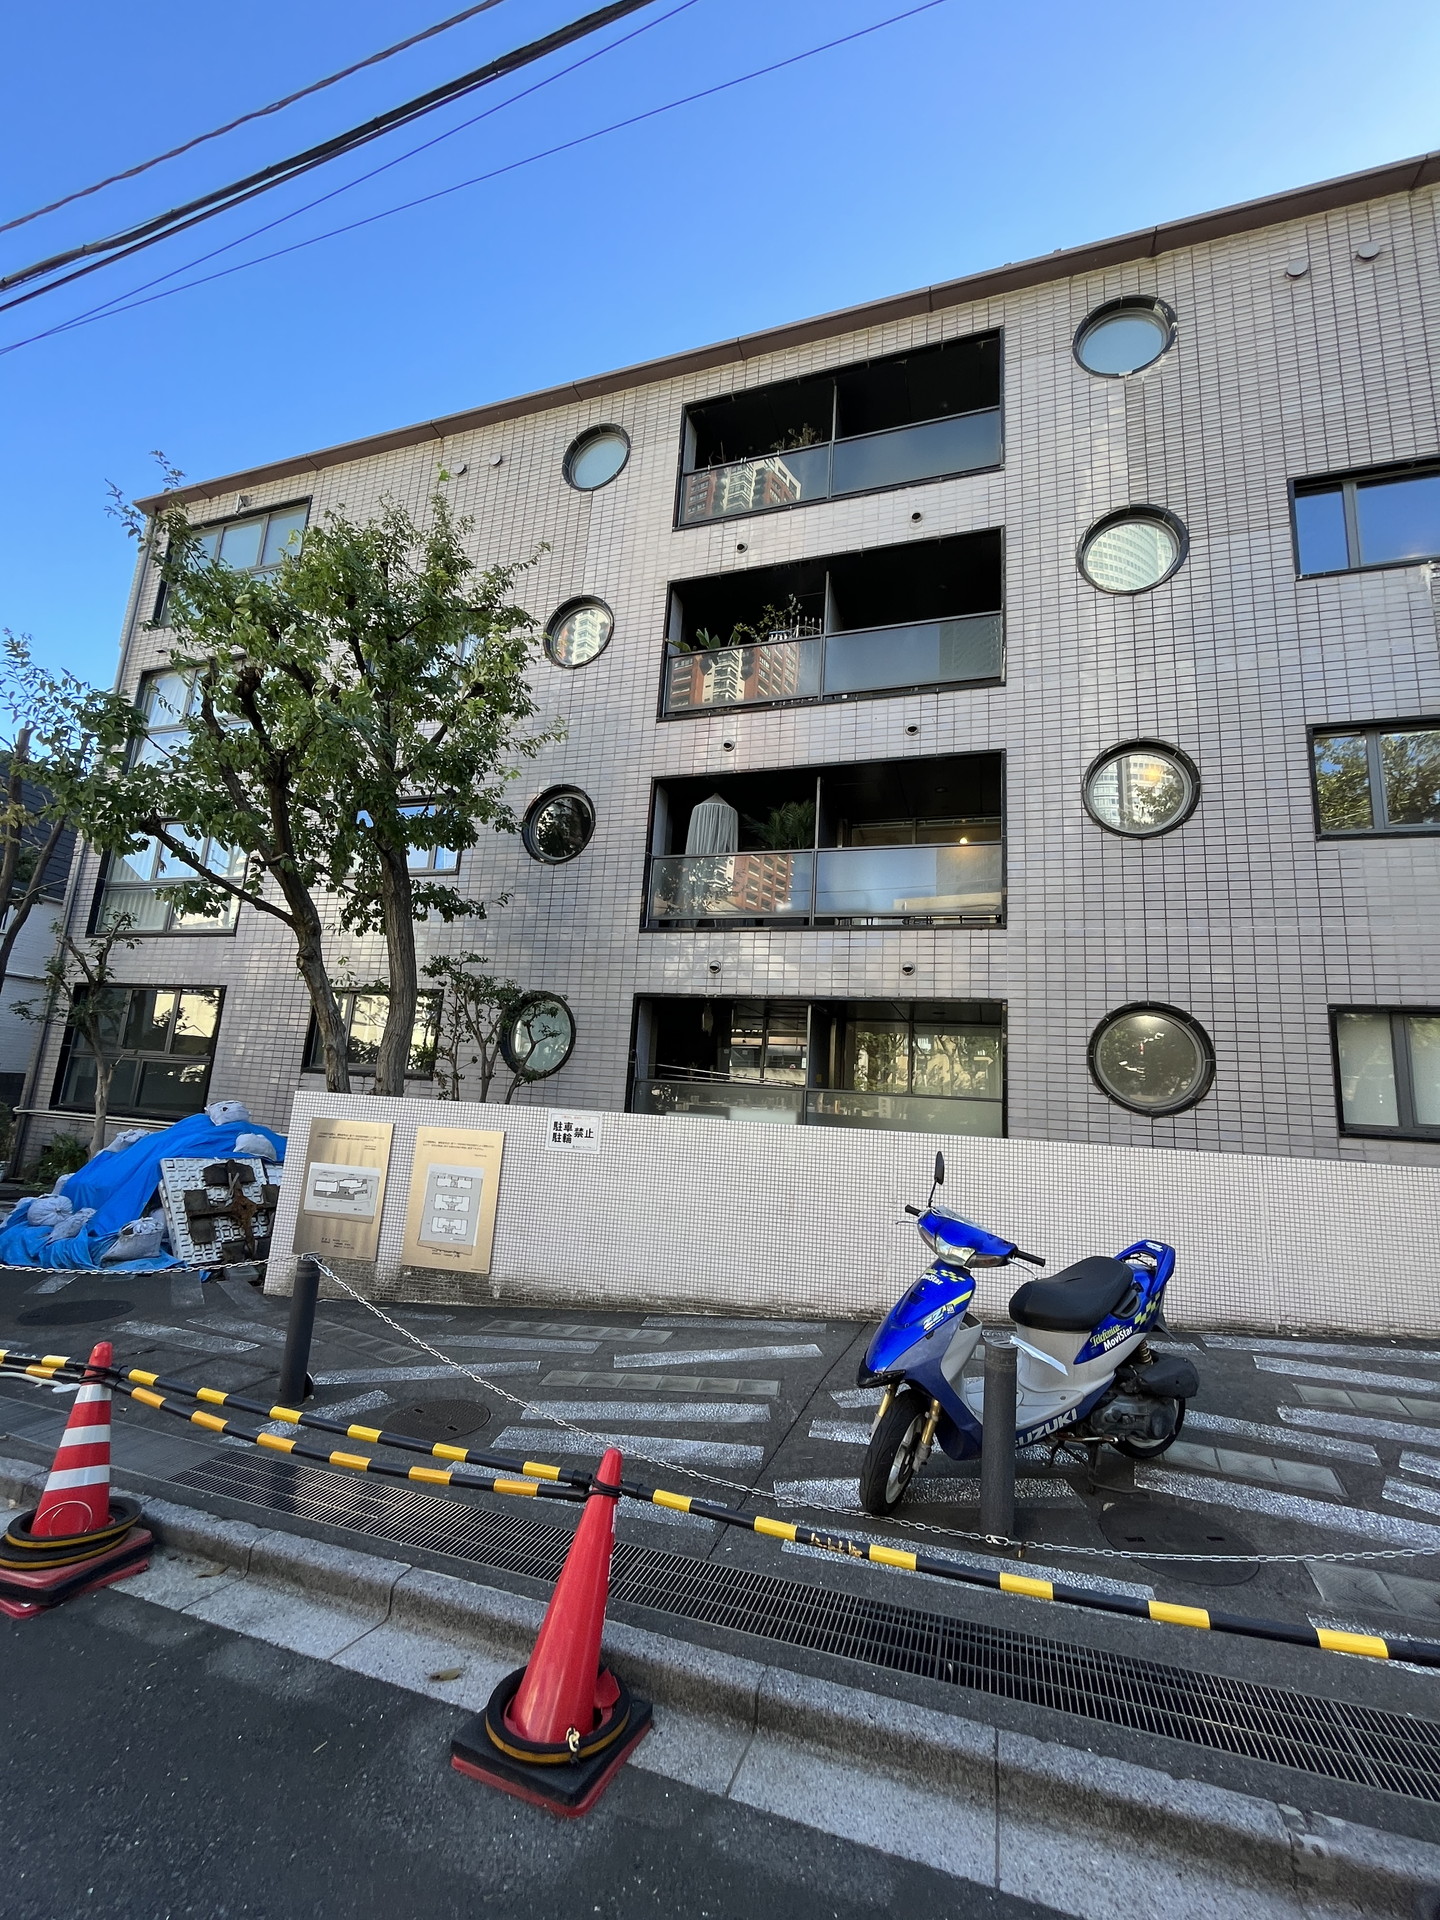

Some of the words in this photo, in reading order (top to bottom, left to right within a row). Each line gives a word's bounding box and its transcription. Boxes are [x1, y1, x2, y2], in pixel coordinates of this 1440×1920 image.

[553, 1121, 573, 1132] 駐車
[552, 1132, 573, 1144] 駐輪
[574, 1127, 594, 1139] 禁止
[1103, 1326, 1133, 1352] MoviStar
